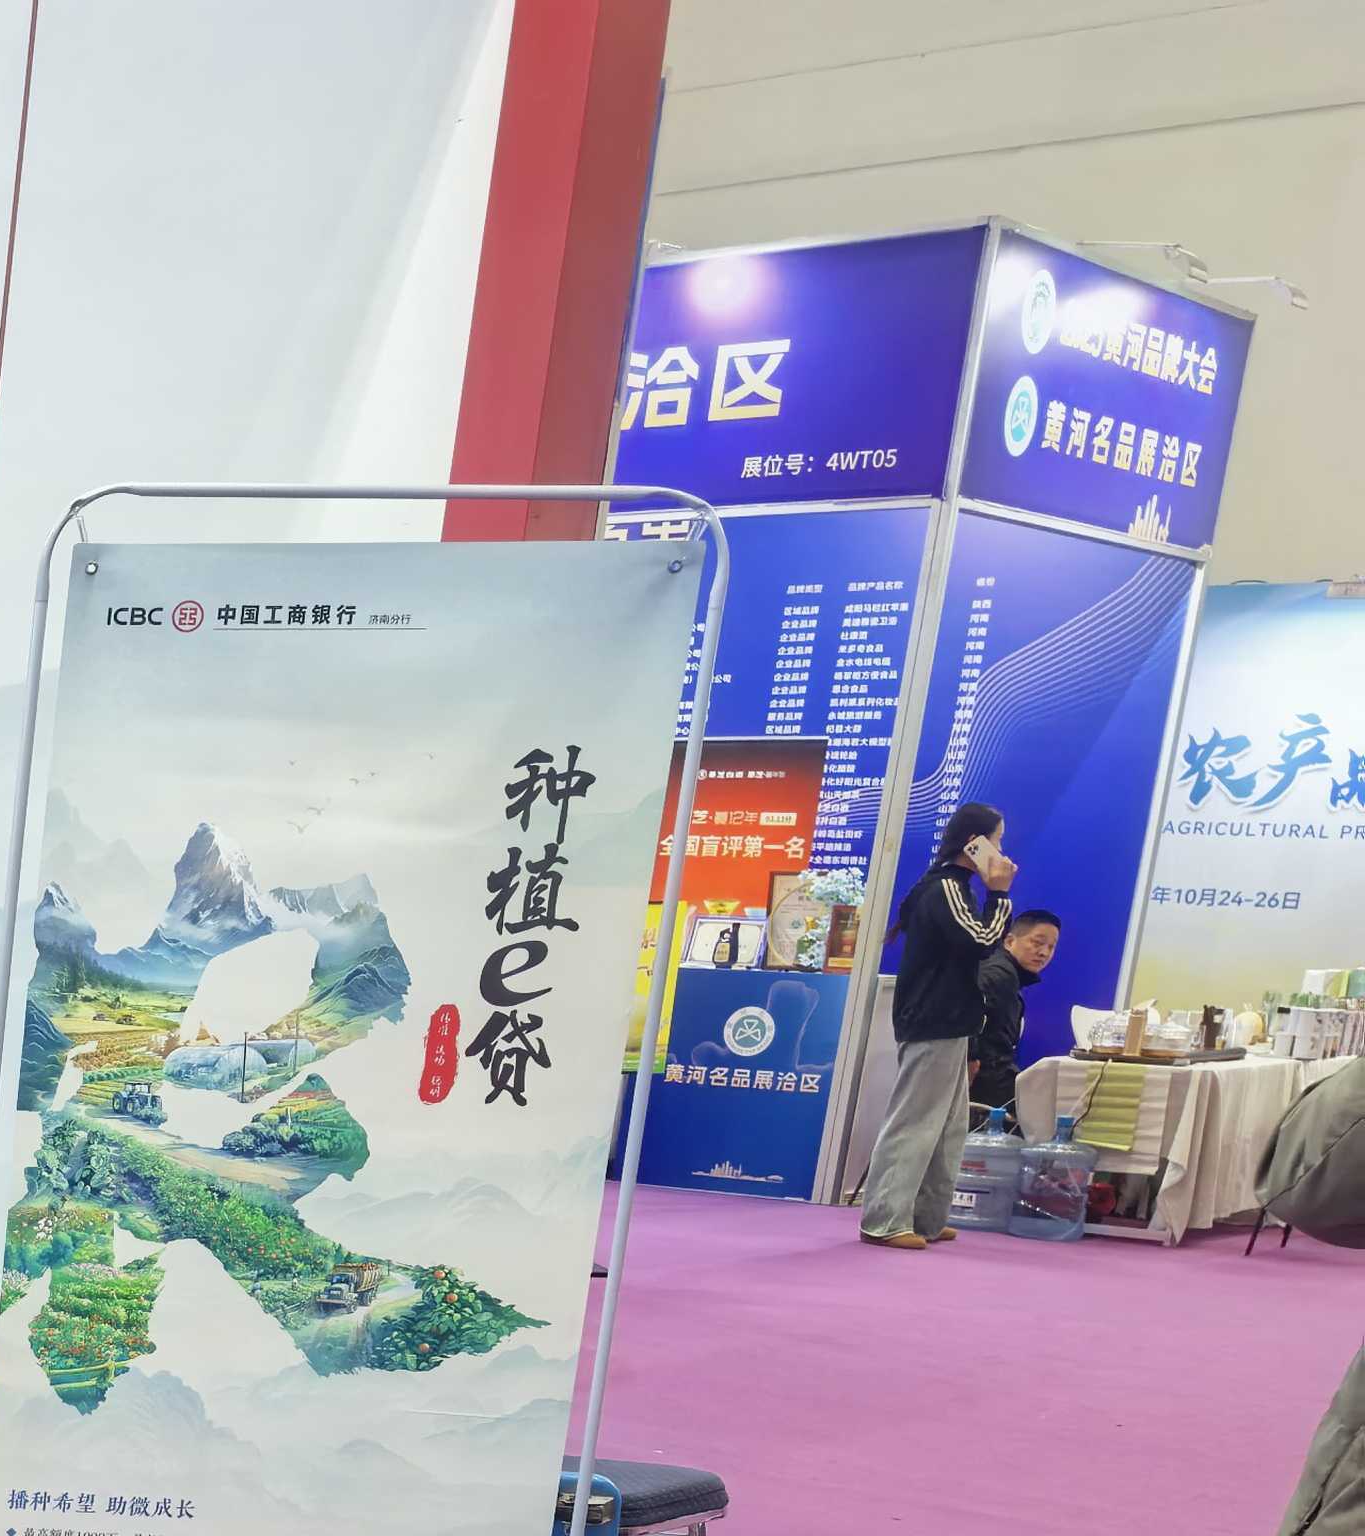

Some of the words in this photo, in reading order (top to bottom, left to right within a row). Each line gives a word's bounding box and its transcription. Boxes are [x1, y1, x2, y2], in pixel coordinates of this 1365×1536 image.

[620, 338, 792, 430] 洽区
[1040, 399, 1203, 488] 黄河名品展洽区
[106, 606, 164, 627] ICBC
[216, 603, 358, 627] 中国工商银行
[368, 612, 412, 626] 济南分行
[1162, 820, 1329, 840] AGRICULTURAL
[1150, 886, 1302, 910] 年10月24-26日
[465, 744, 597, 1107] 种植e贷
[663, 1062, 822, 1093] 黄河名品展洽区
[7, 1489, 97, 1514] 播种希望
[105, 1495, 196, 1519] 助微成长
